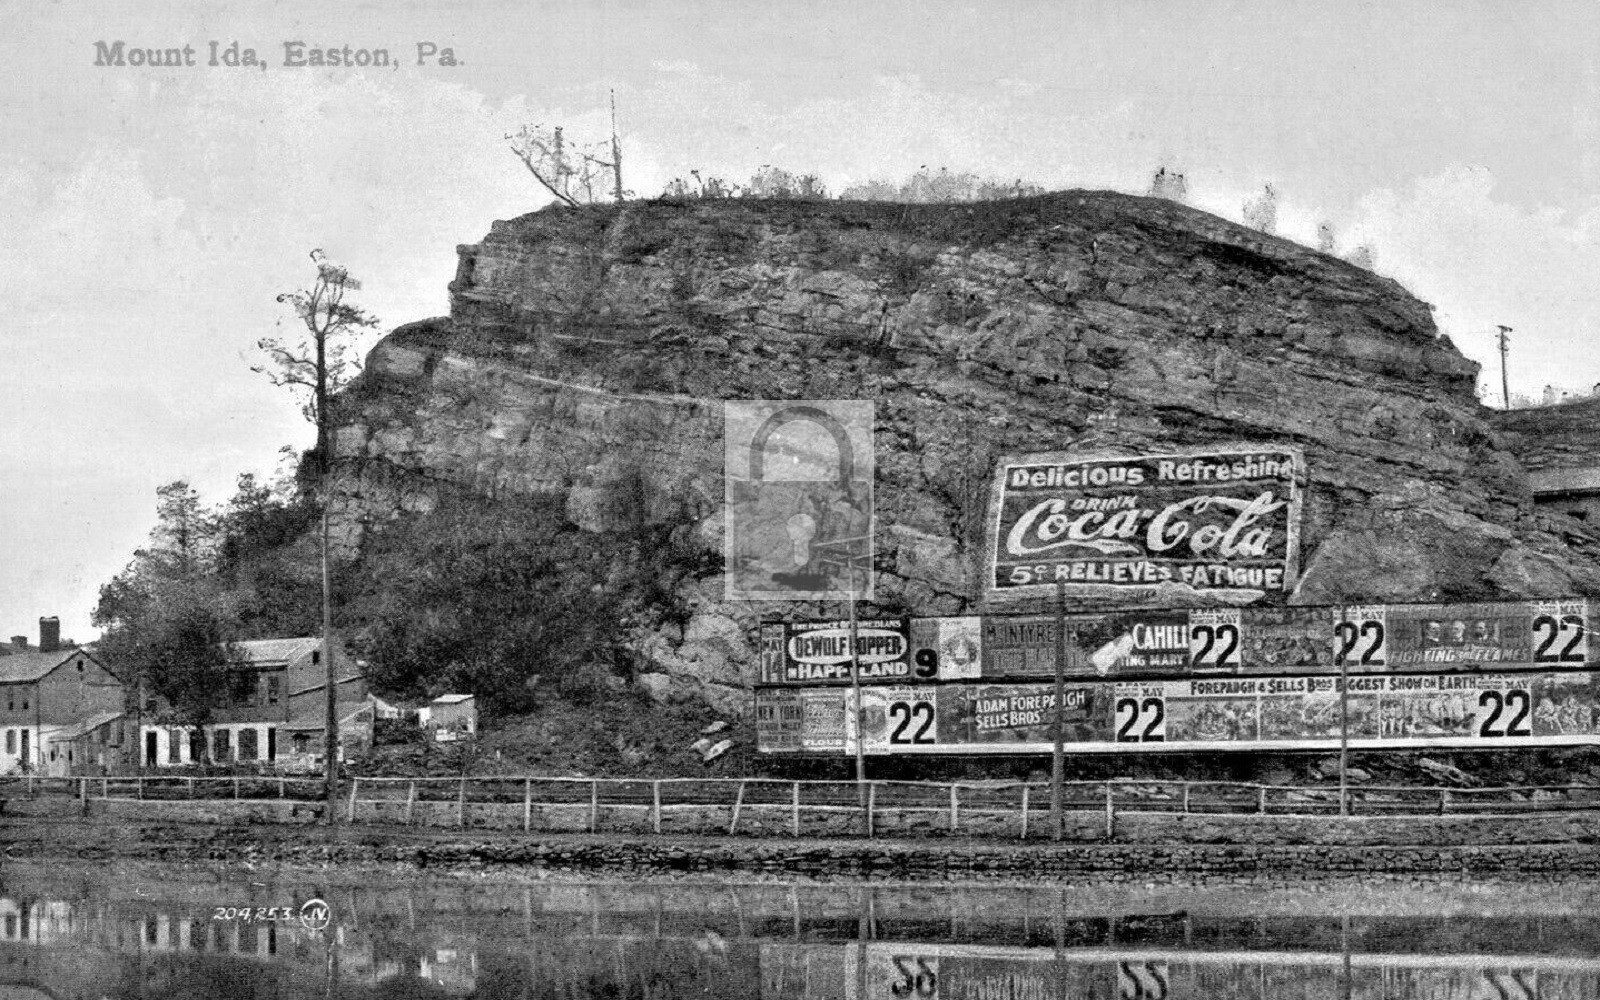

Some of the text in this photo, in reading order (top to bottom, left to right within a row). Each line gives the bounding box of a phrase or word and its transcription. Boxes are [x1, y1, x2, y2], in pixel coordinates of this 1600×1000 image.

[1011, 465, 1144, 487] Delicious
[1071, 496, 1139, 511] DRINK
[1054, 561, 1172, 582] RELIEVES
[1179, 564, 1284, 589] FATIGUE
[795, 636, 847, 658] DEWOLF
[1132, 623, 1188, 649] CAHILL
[1192, 624, 1239, 668] 22
[1335, 620, 1385, 666] 22
[1532, 615, 1585, 662] 22
[915, 648, 938, 678] 9
[1142, 687, 1164, 697] MAY
[1191, 681, 1256, 695] FOREPAUGH
[1268, 679, 1305, 693] SELLS
[1335, 677, 1385, 692] BGGEST
[1389, 677, 1422, 691] SHOW
[1424, 678, 1436, 688] ON
[1438, 676, 1476, 690] EARTH
[1505, 681, 1528, 689] MAY
[975, 691, 1085, 713] ADAM FOREPAGH
[1479, 690, 1531, 737] 22
[889, 701, 935, 744] 22
[975, 713, 1008, 730] SELLS
[1116, 698, 1164, 742] 22
